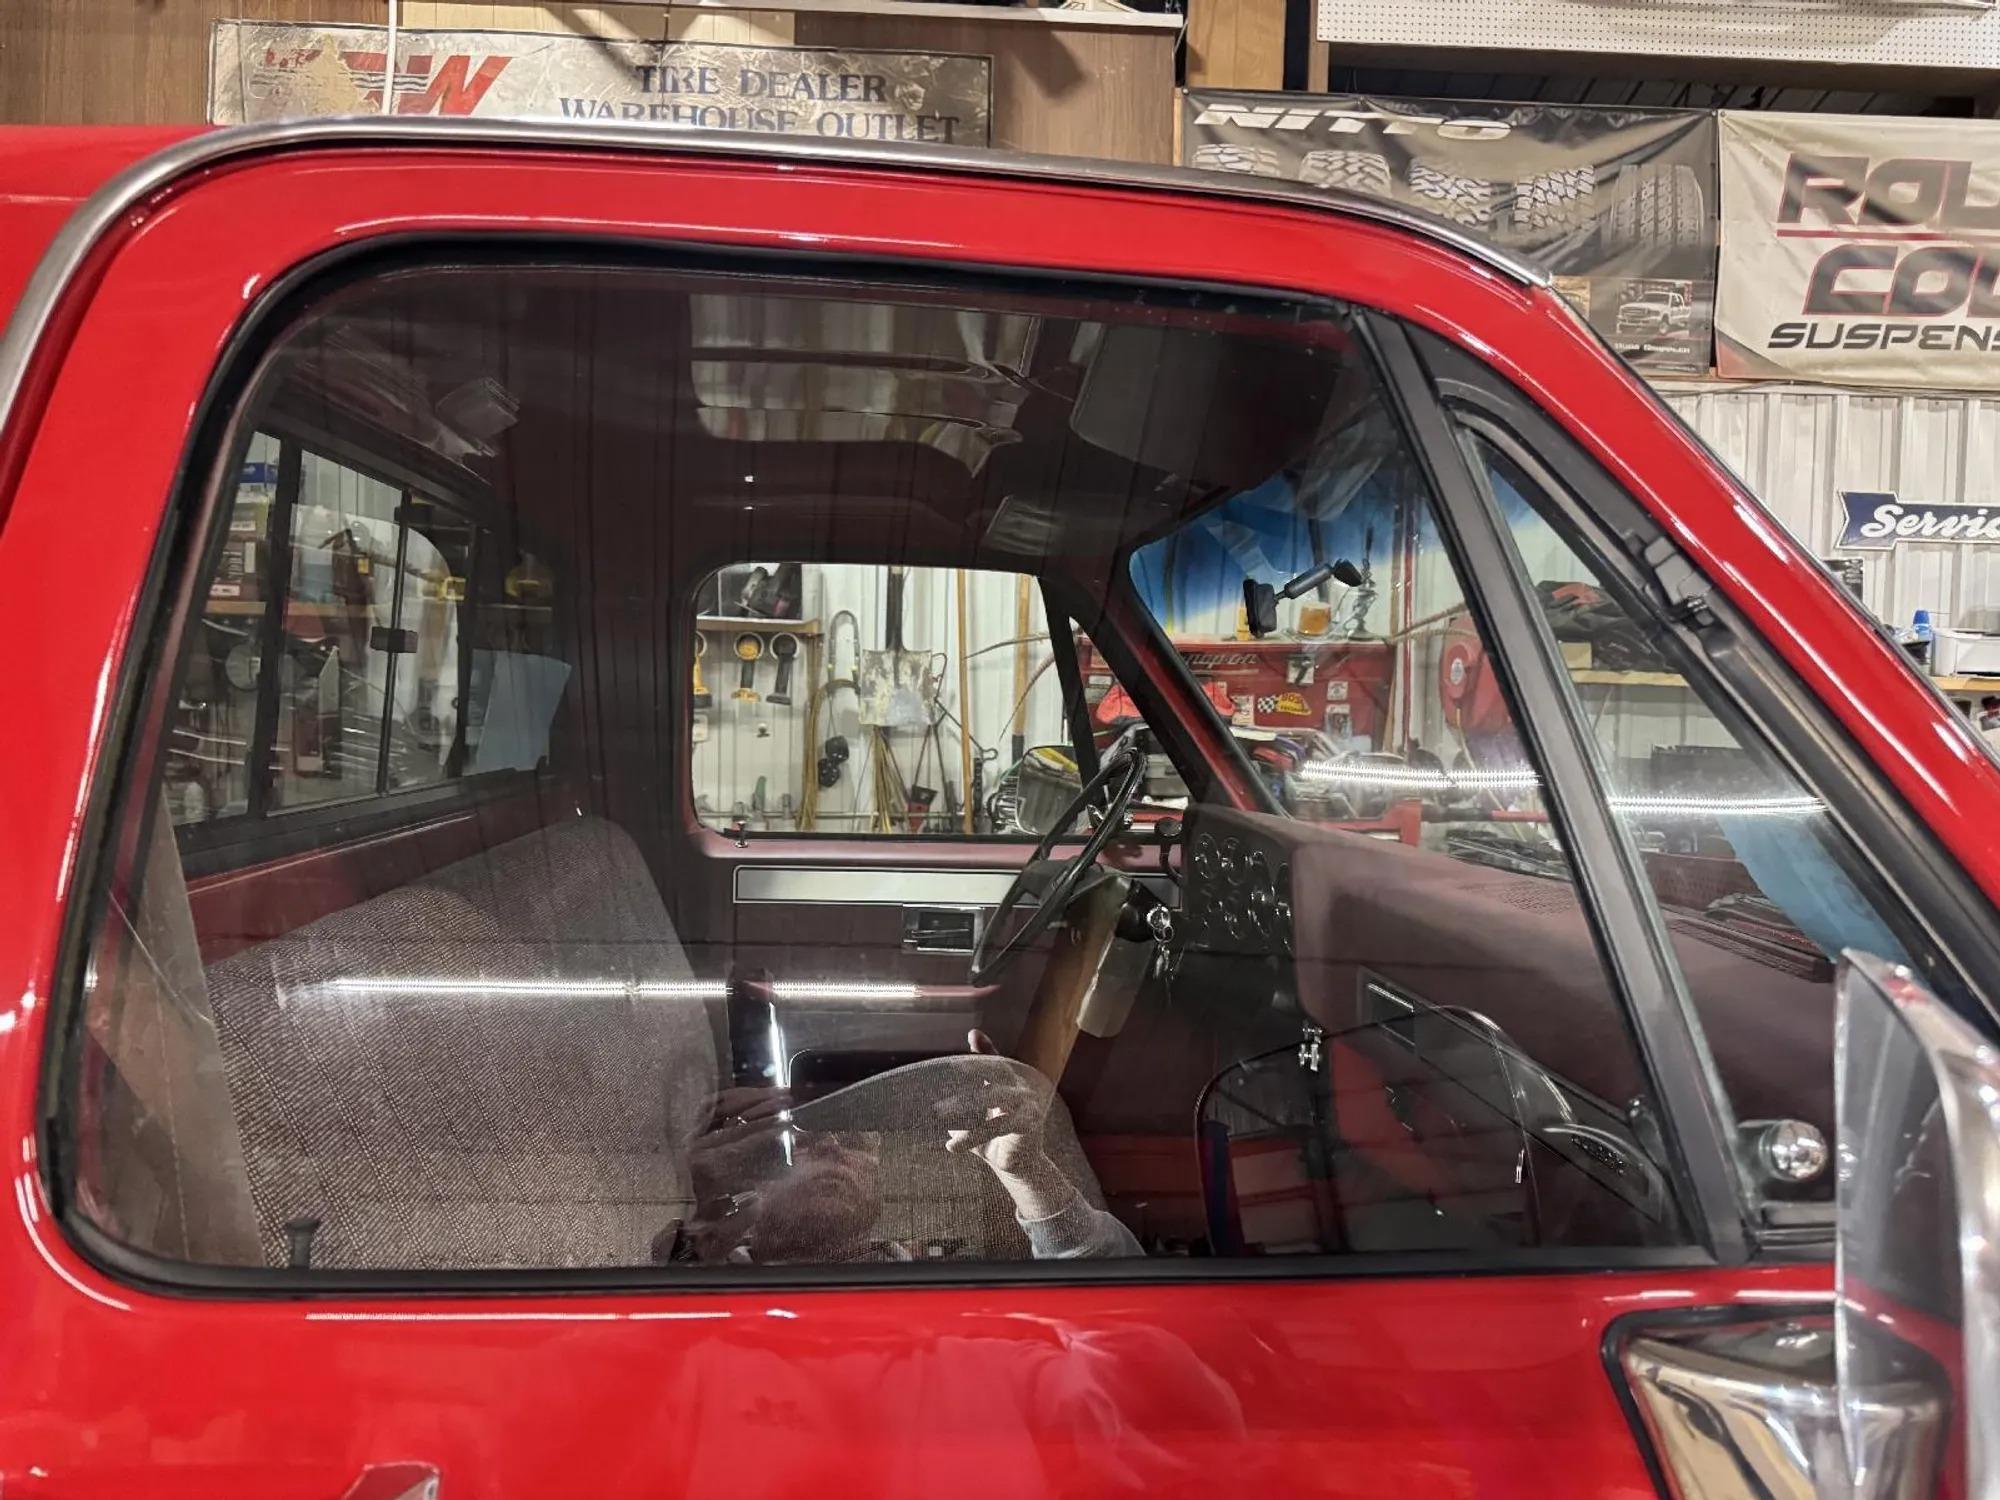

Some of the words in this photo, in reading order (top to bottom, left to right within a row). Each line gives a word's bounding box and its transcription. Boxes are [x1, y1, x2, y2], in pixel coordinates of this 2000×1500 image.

[635, 64, 721, 95] TIRE
[740, 69, 888, 103] DEALER
[560, 97, 798, 132] WAREHOUSE
[816, 111, 960, 145] OUTLET
[1194, 103, 1512, 141] NITTO
